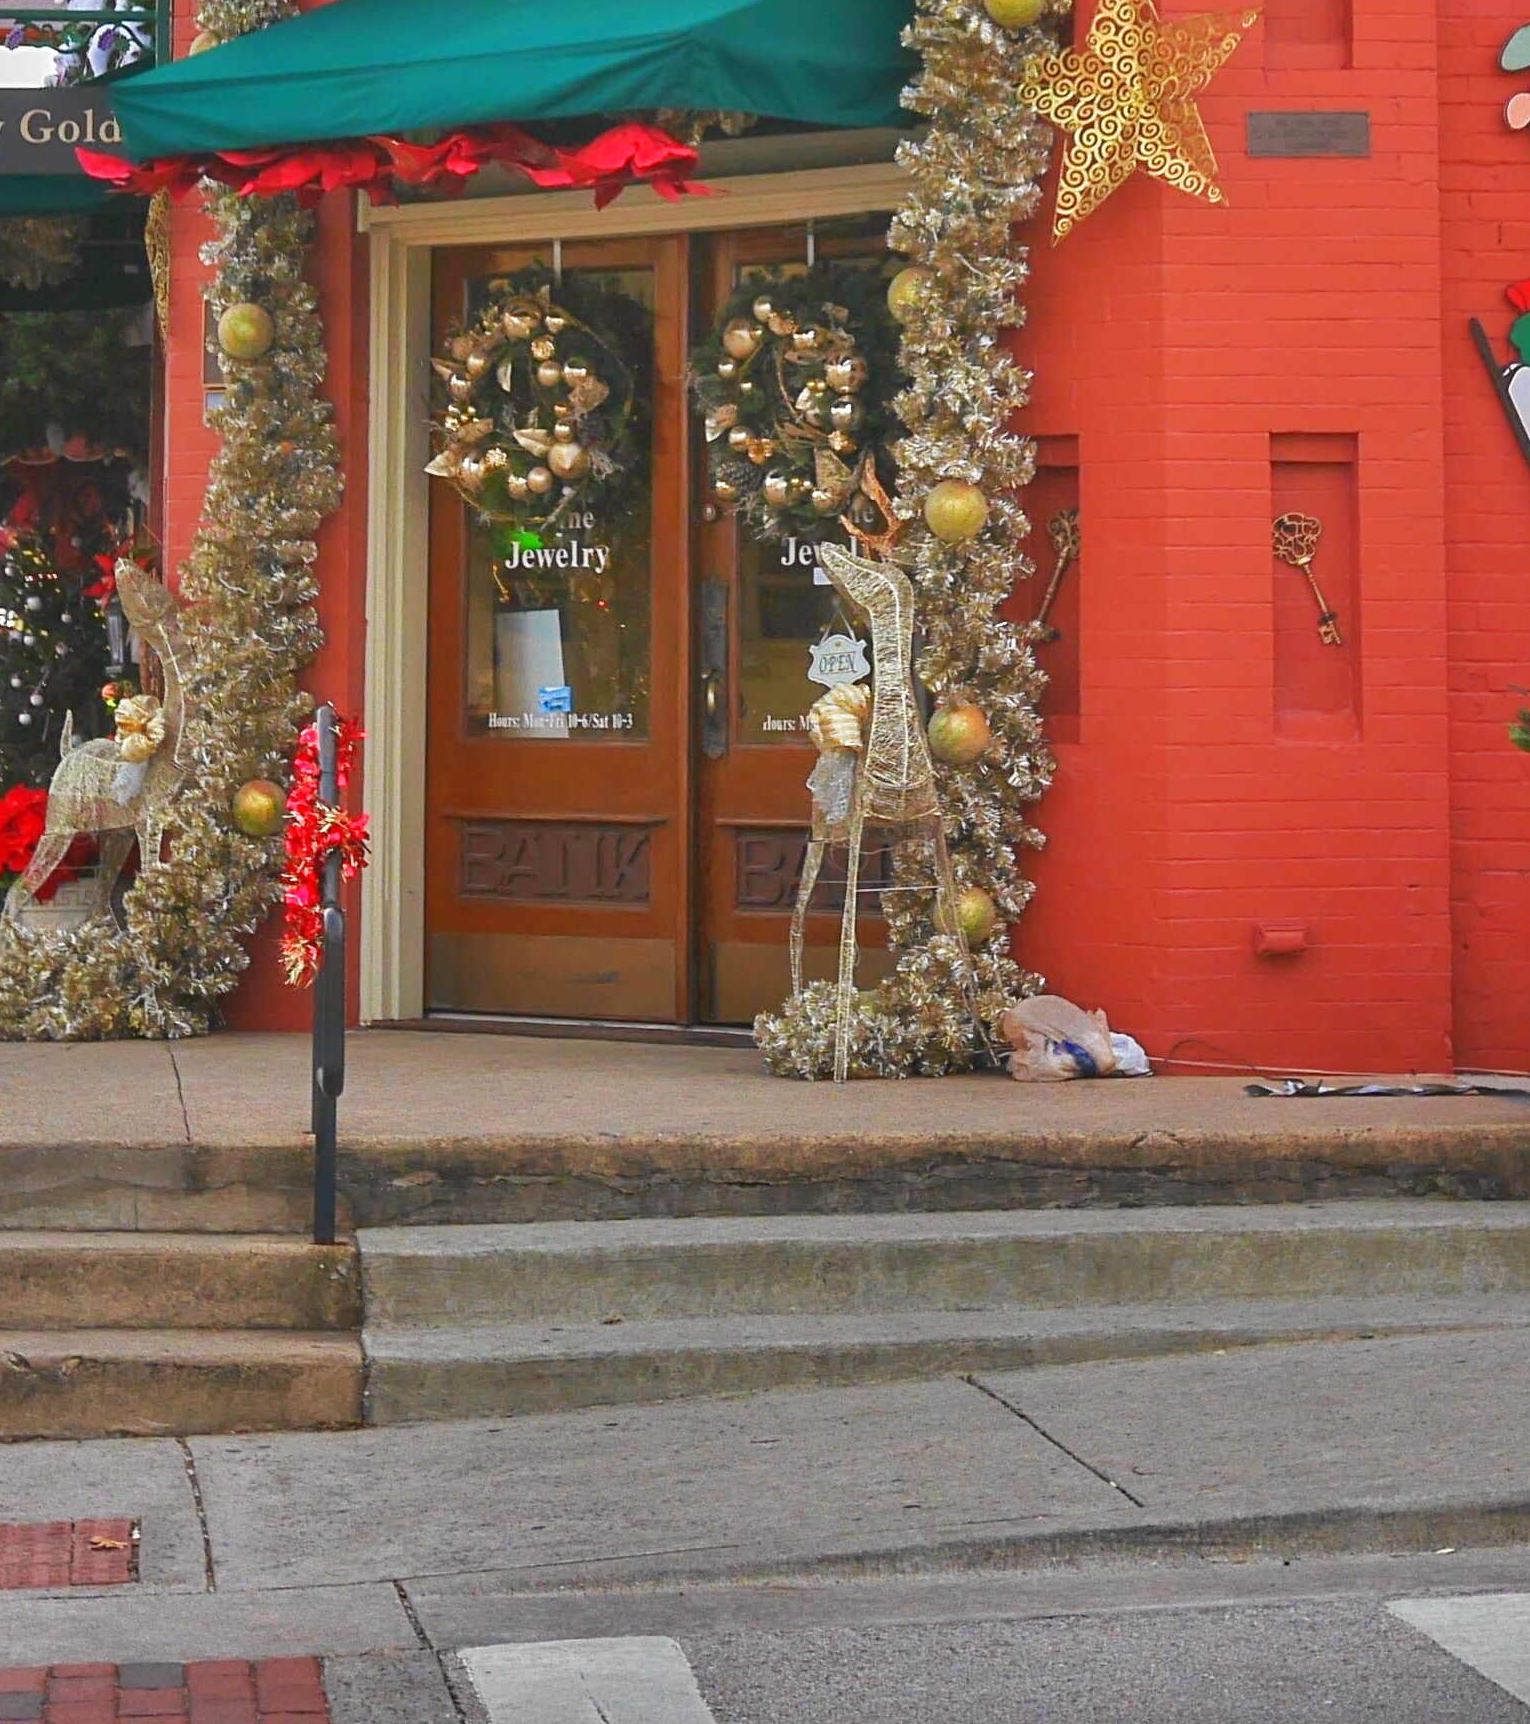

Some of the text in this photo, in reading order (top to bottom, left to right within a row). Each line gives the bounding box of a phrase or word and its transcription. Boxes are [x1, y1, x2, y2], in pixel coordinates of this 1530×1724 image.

[19, 108, 123, 144] Gold
[505, 540, 610, 574] Jewelry
[819, 654, 857, 673] OPEN
[488, 713, 520, 728] Hours:
[461, 830, 651, 902] BANK
